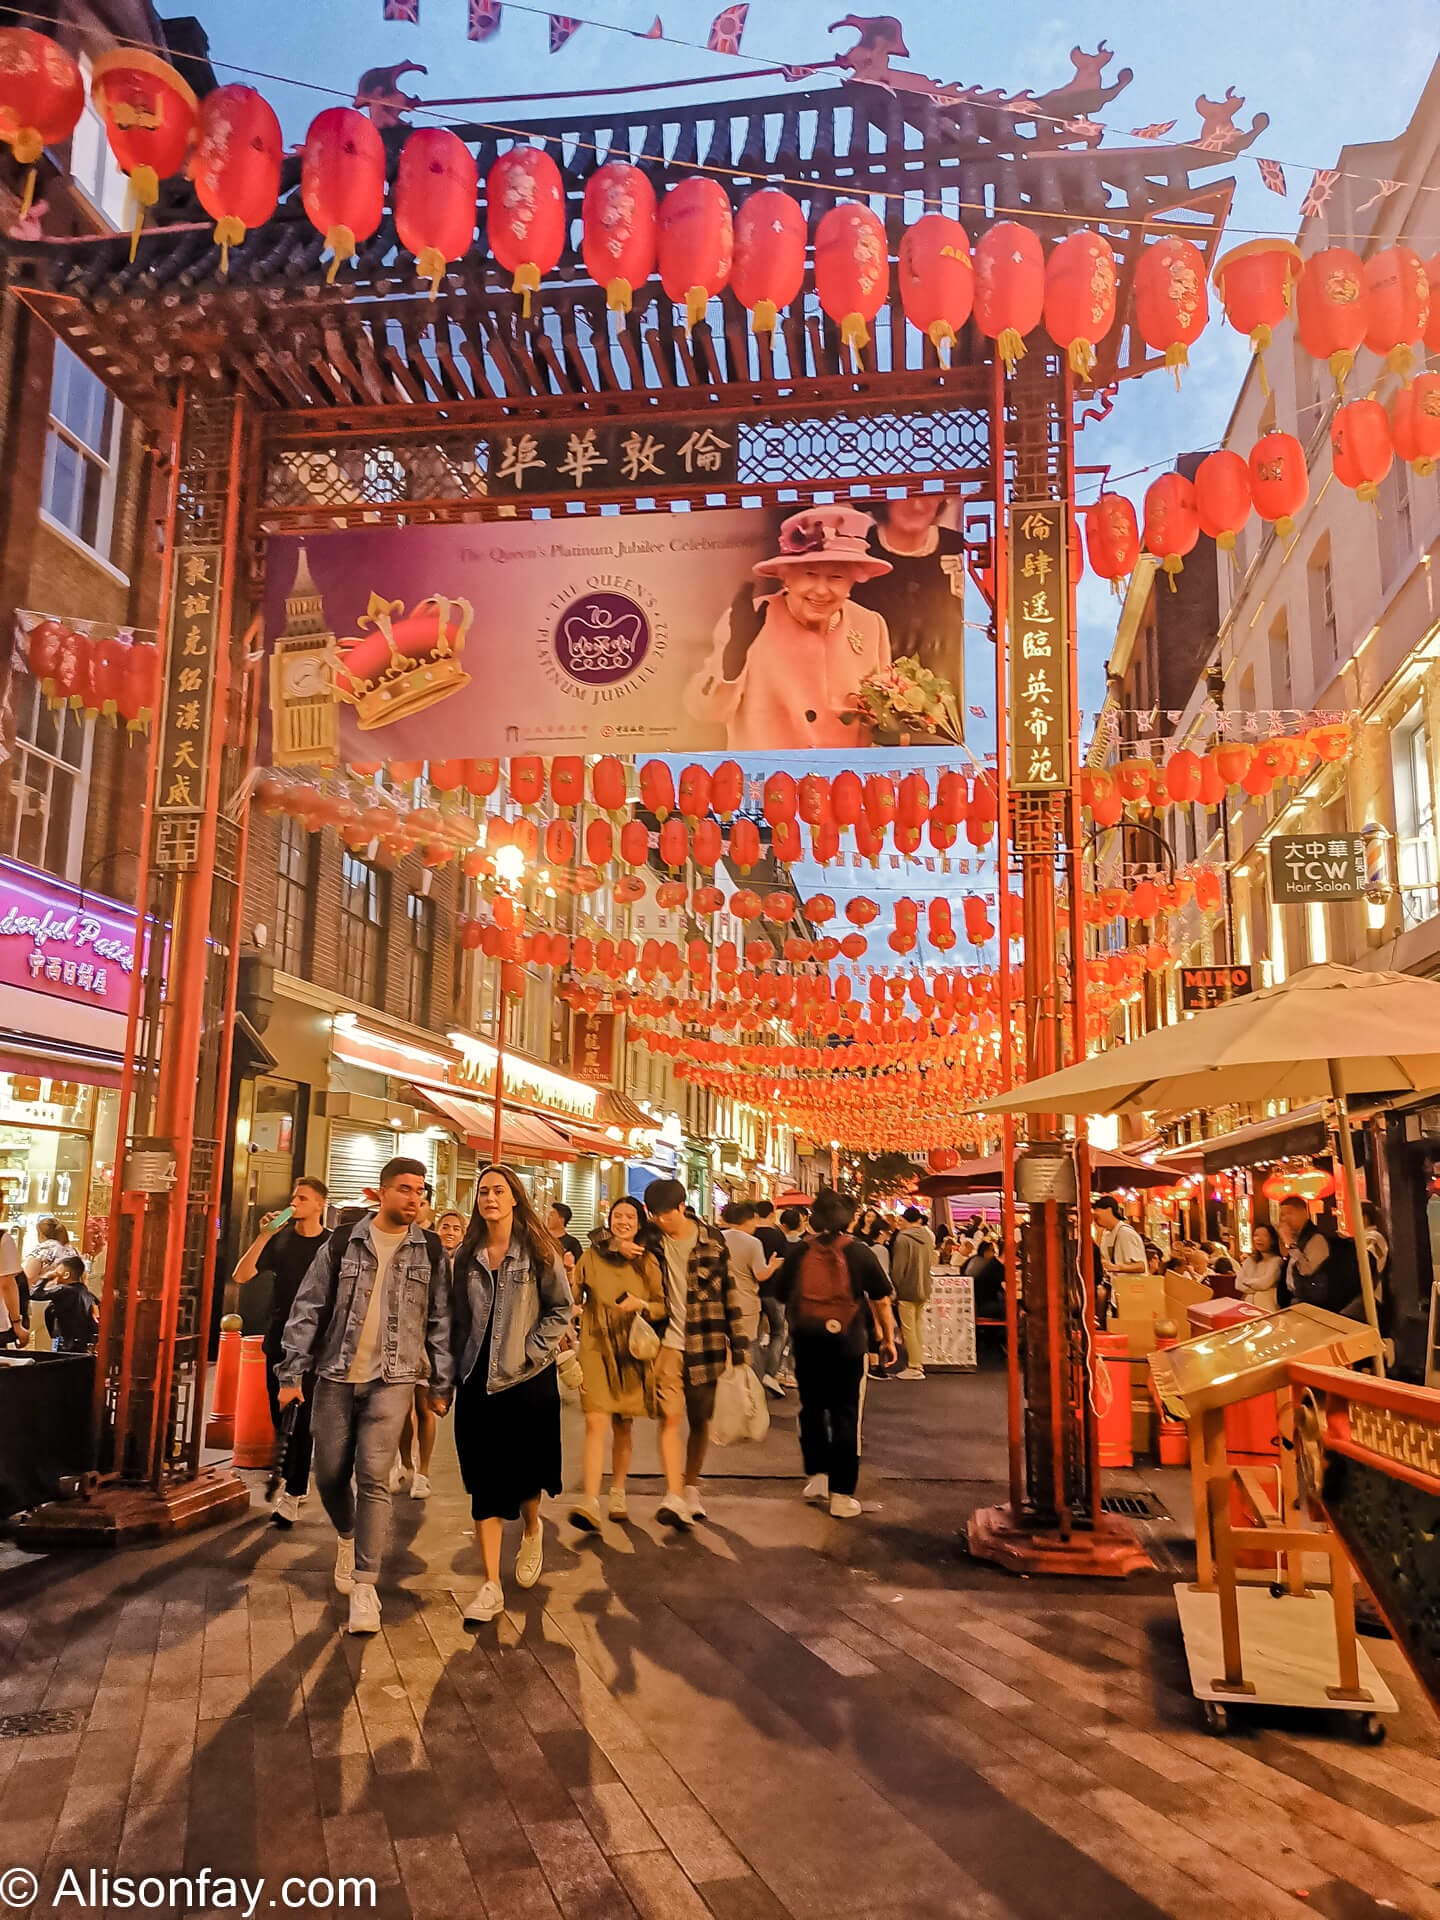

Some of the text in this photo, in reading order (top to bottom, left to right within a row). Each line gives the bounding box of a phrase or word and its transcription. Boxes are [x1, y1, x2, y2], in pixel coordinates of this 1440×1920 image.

[489, 547, 546, 564] Queen's
[550, 543, 614, 557] Platinum
[615, 539, 665, 558] Jubilee
[586, 574, 658, 608] QUEEN'S
[1284, 840, 1349, 860] 大中華
[1285, 861, 1348, 881] TCW
[1286, 880, 1351, 893] Hair Salon
[938, 1278, 969, 1288] OPEN
